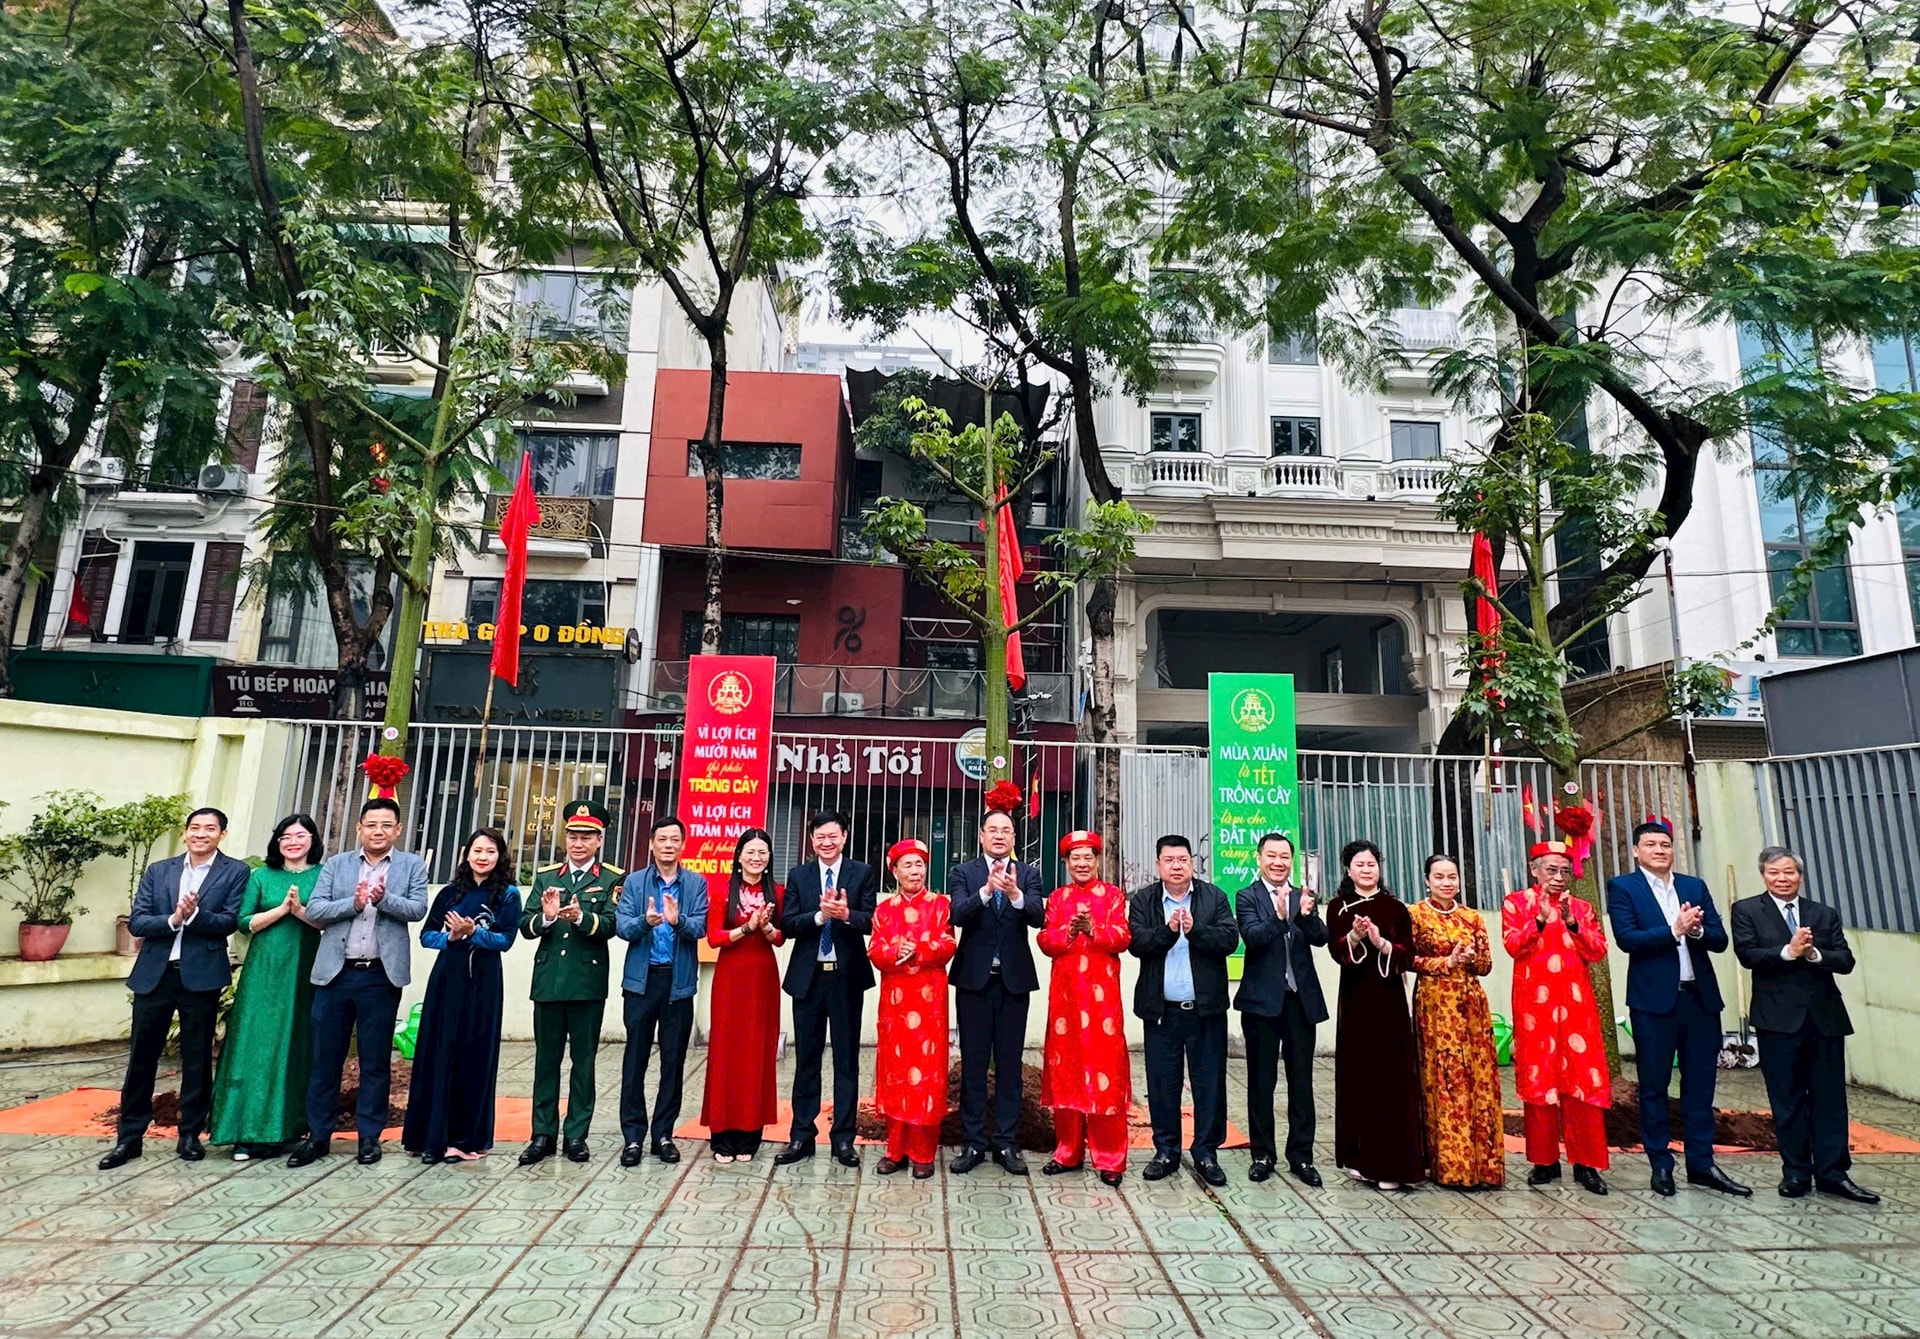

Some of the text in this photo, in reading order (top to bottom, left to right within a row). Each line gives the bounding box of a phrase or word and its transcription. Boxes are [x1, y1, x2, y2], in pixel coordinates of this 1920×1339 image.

[423, 617, 469, 640] TRẢ
[477, 622, 528, 641] GP
[558, 618, 625, 645] ĐỒNG
[227, 670, 250, 692] TỦ
[254, 670, 289, 693] BẾP
[293, 675, 336, 695] HOÀ
[698, 722, 757, 743] VÌ LỢI ÍCH
[694, 742, 757, 759] MƯỜI NĂM
[776, 743, 923, 775] Nhà Tôi
[1219, 742, 1288, 762] MÙA XUÂN
[688, 770, 759, 794] TRỒNG CÂY
[1238, 761, 1276, 785] là TẾT
[1218, 780, 1292, 805] TRỒNG CÂY
[641, 801, 653, 813] 76
[691, 801, 752, 822] VÌ LỢI ÍCH
[1220, 808, 1267, 825] làm cho
[690, 822, 721, 838] TRĂM
[1219, 823, 1247, 845] ĐẤT
[713, 840, 736, 856] phả
[1220, 845, 1250, 867] càng
[681, 850, 718, 874] TRỒNG
[1222, 862, 1249, 882] càng
